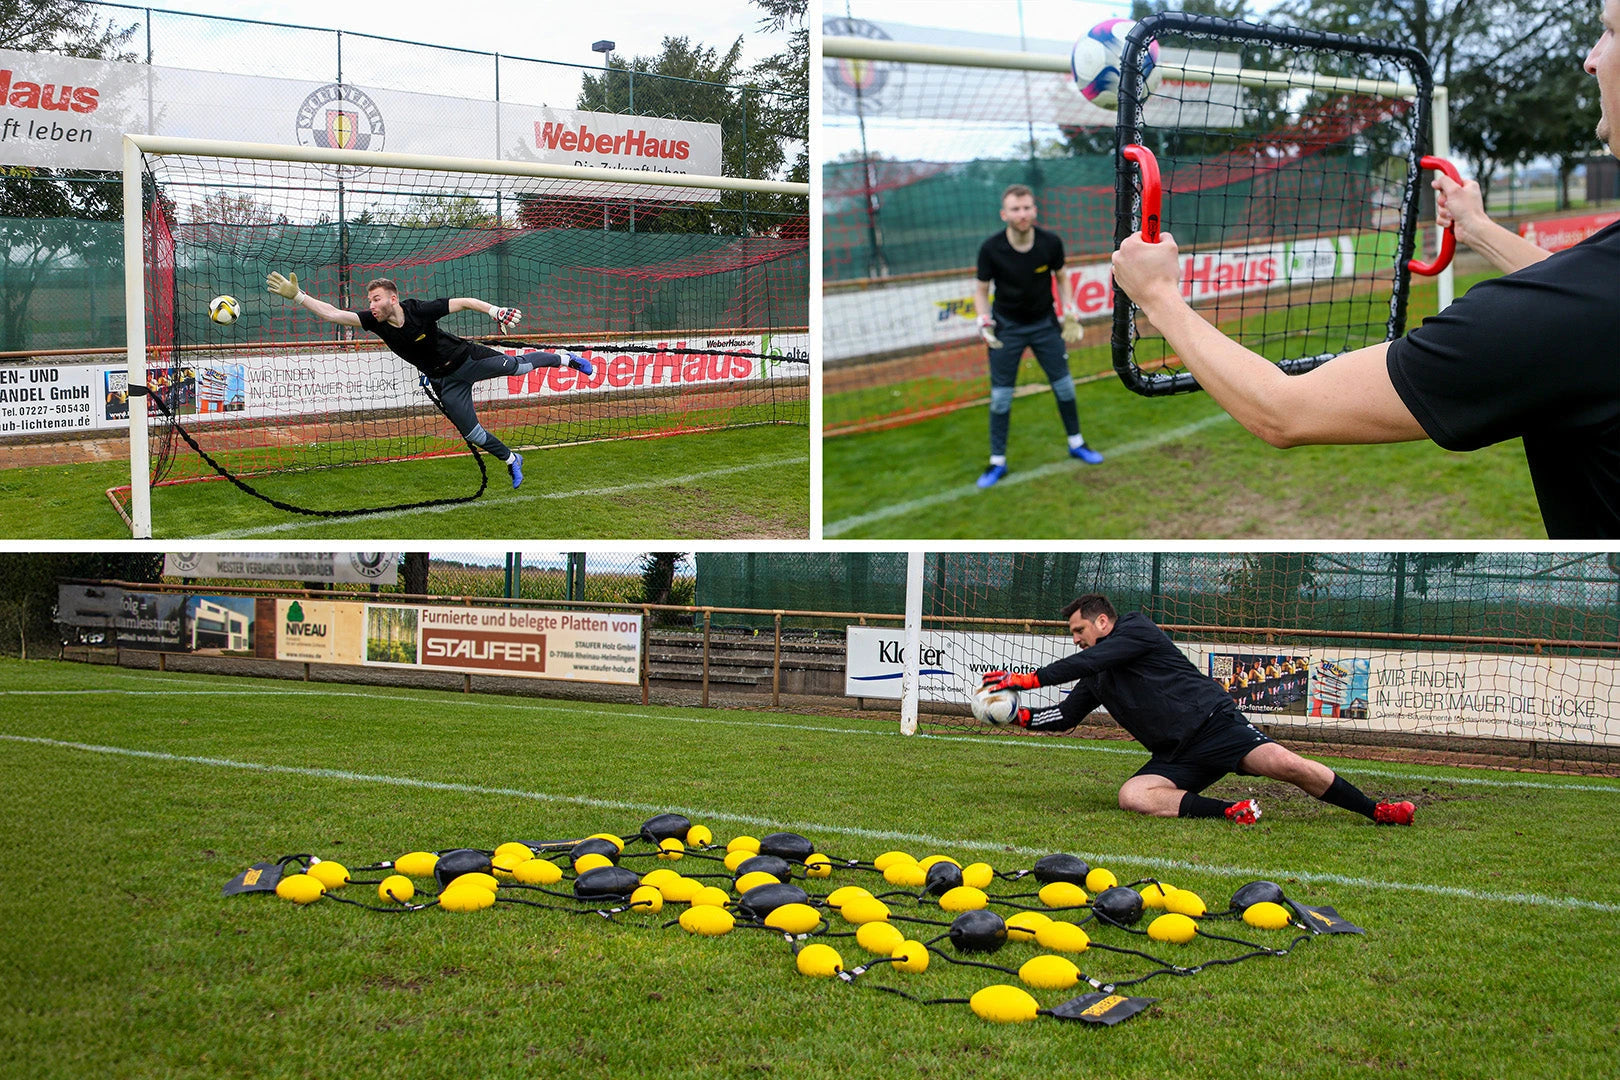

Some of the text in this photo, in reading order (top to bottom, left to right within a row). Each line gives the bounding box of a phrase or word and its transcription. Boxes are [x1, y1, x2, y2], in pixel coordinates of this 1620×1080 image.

[28, 120, 92, 142] leben
[533, 121, 690, 160] WeberHaus
[706, 338, 755, 349] WeberHaus.de
[29, 368, 59, 383] UND
[250, 368, 316, 383] WIR FINDEN
[504, 341, 753, 394] WeberHaus
[0, 385, 89, 403] ANDEL GmbH
[250, 386, 262, 399] IN
[264, 384, 301, 399] JEDER
[304, 381, 343, 396] MAUER
[346, 380, 362, 394] DIE
[2, 403, 90, 417] Tel. 07227-505430
[0, 416, 91, 432] ub-lichtenau.de
[286, 623, 327, 637] NIVEAU
[422, 609, 637, 633] Furnierte und belegte Platten von
[426, 637, 541, 663] STAUFER
[574, 641, 636, 651] STAUFER Holz GmbH
[878, 640, 946, 666] Klter
[549, 650, 636, 663] D-77866 Rheinau-Helmlingen
[573, 664, 635, 674] www.staufer-holz.de
[1376, 669, 1467, 689] WIR FINDEN
[1375, 690, 1600, 718] IN JEDER MAUER DIE LÜCKE.
